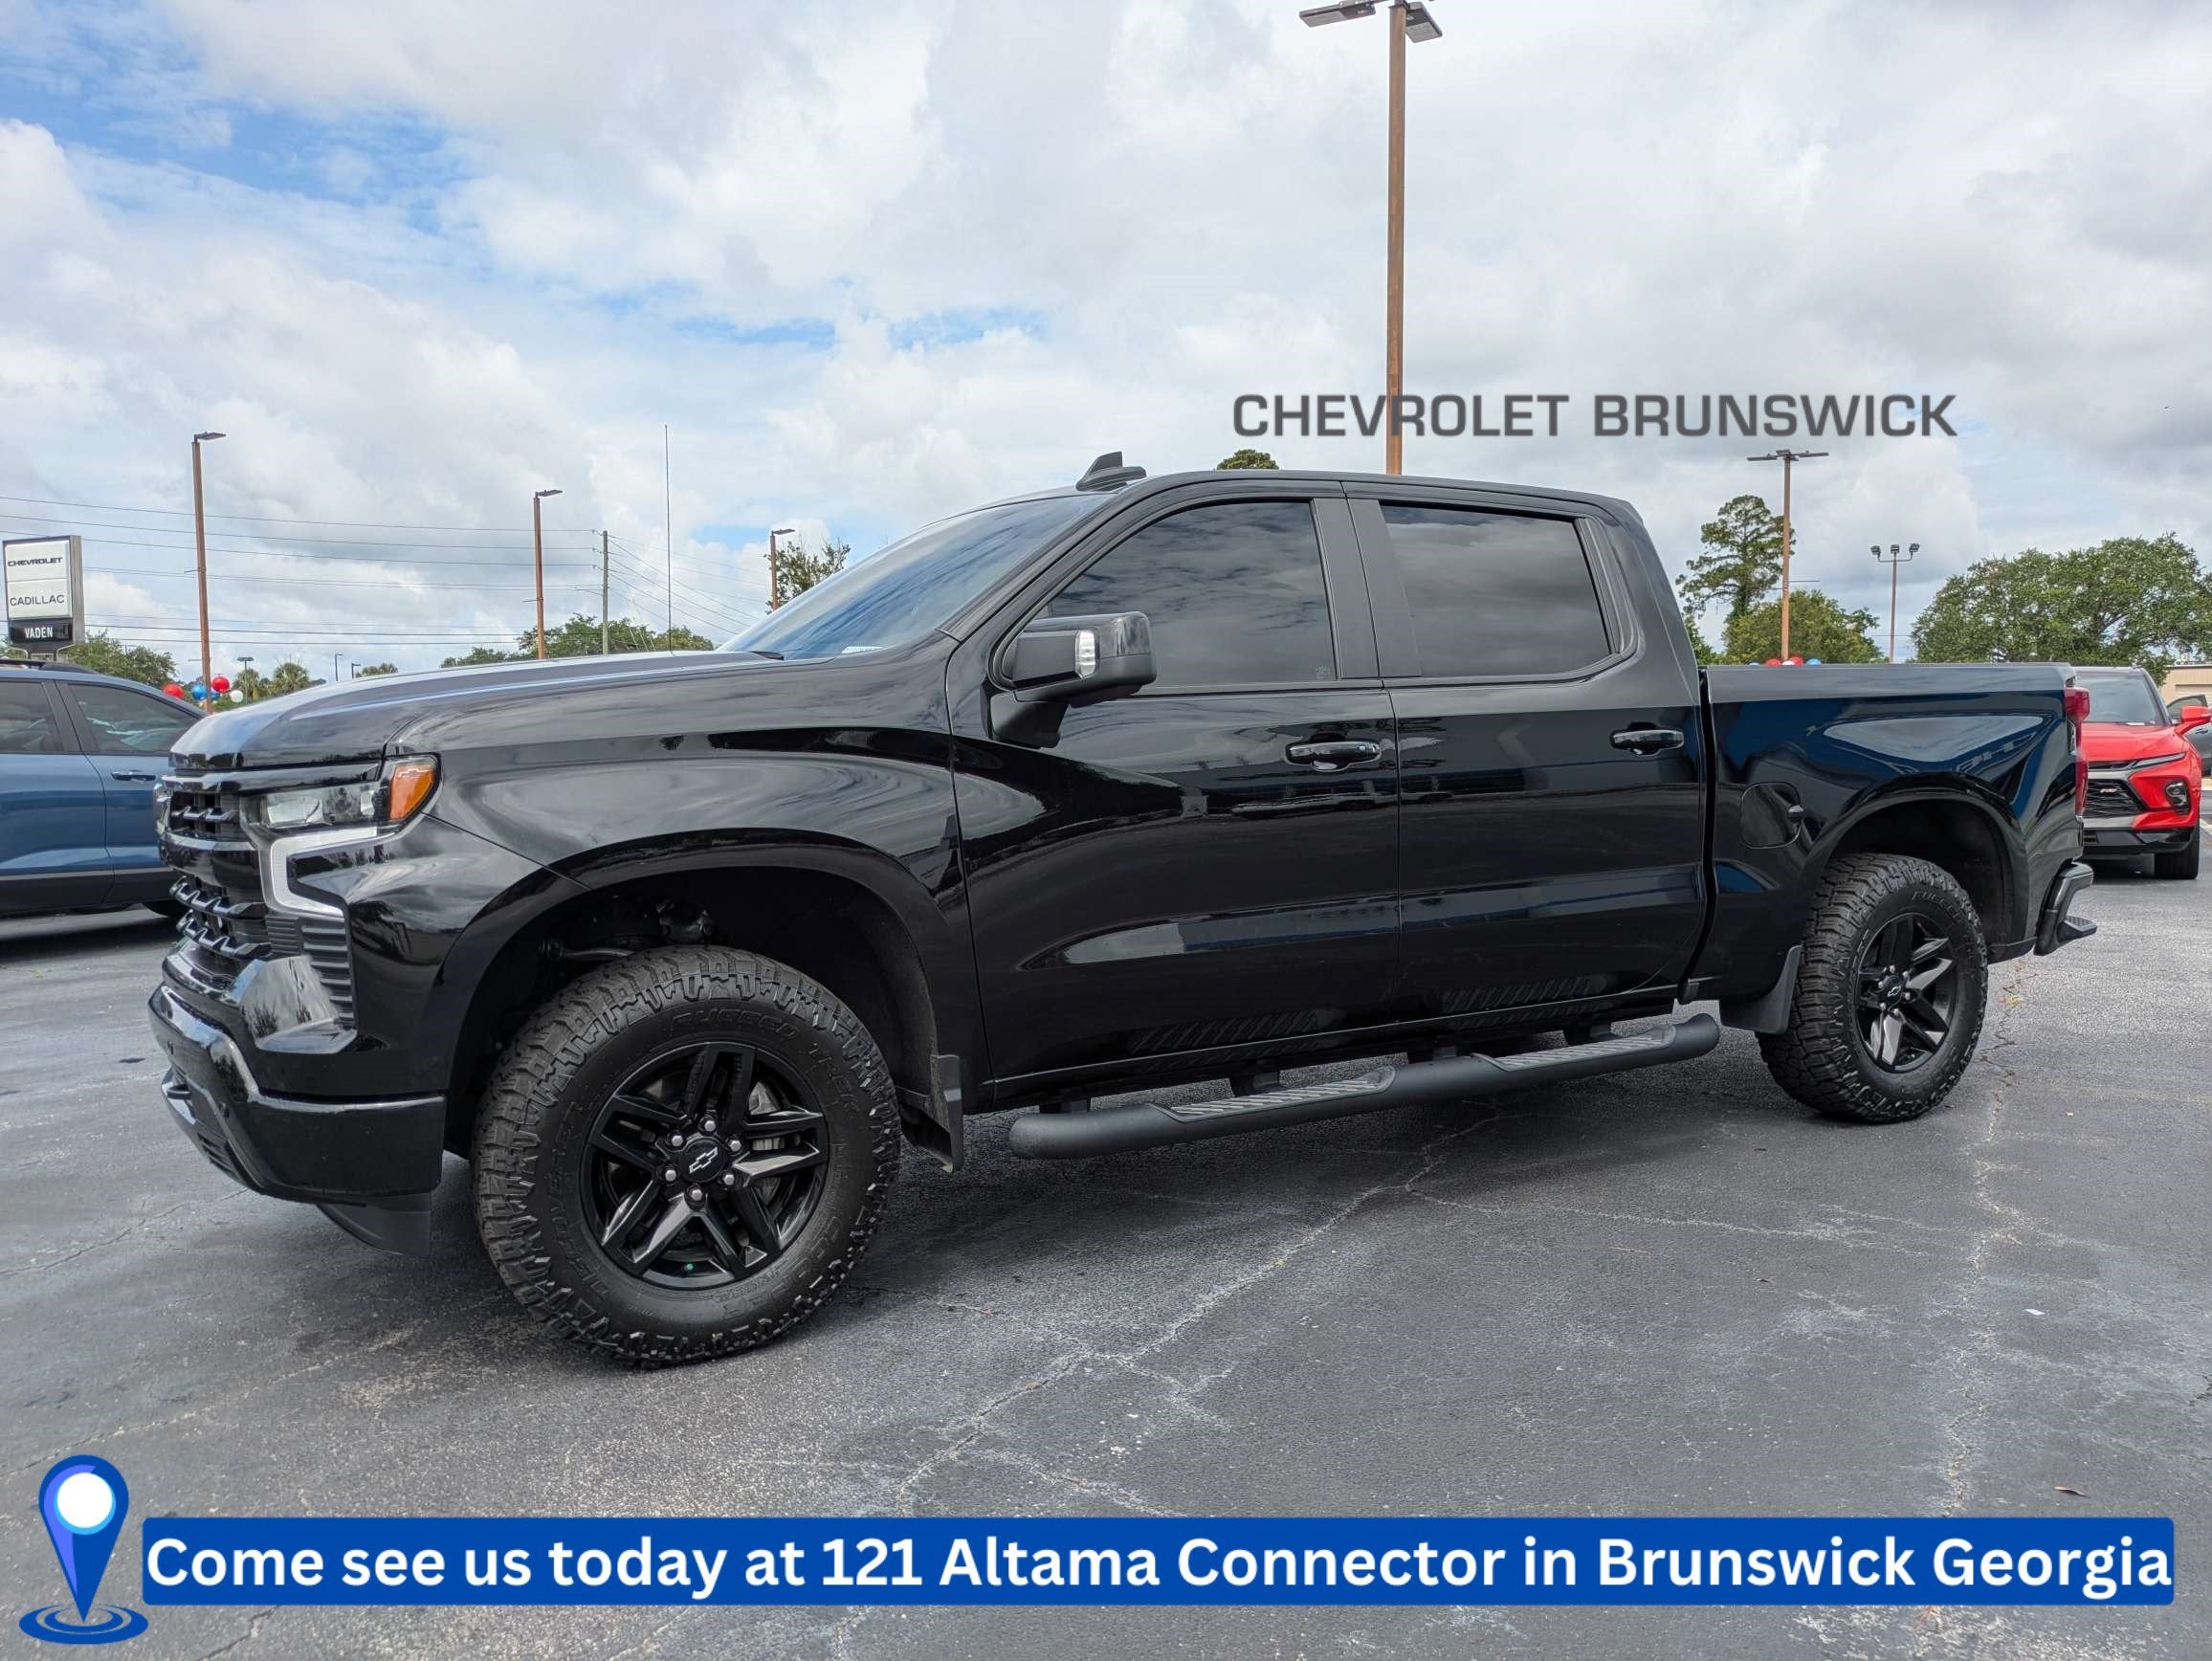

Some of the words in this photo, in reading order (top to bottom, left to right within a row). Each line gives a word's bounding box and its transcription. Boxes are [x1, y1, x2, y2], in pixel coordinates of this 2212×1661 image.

[8, 557, 62, 567] CHEVROLET
[10, 594, 65, 607] CADILLAC
[24, 626, 54, 639] VADEN
